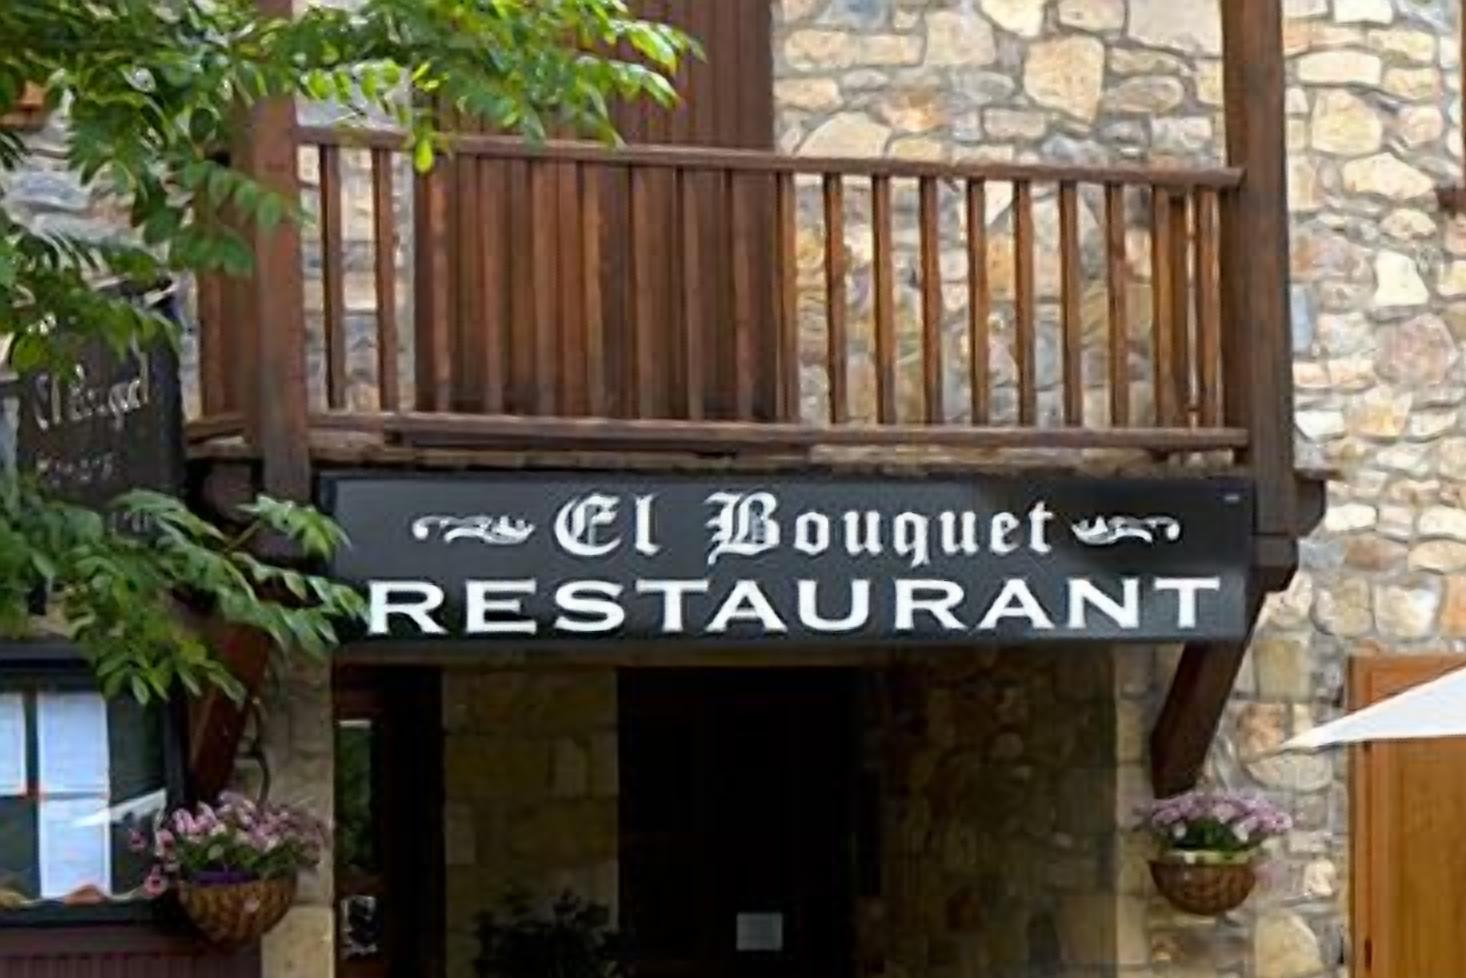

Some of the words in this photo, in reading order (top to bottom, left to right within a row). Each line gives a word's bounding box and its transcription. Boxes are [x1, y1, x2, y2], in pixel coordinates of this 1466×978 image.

[554, 491, 662, 559] El
[706, 491, 1055, 566] Bouquet
[367, 577, 1221, 637] RESTAURANT
